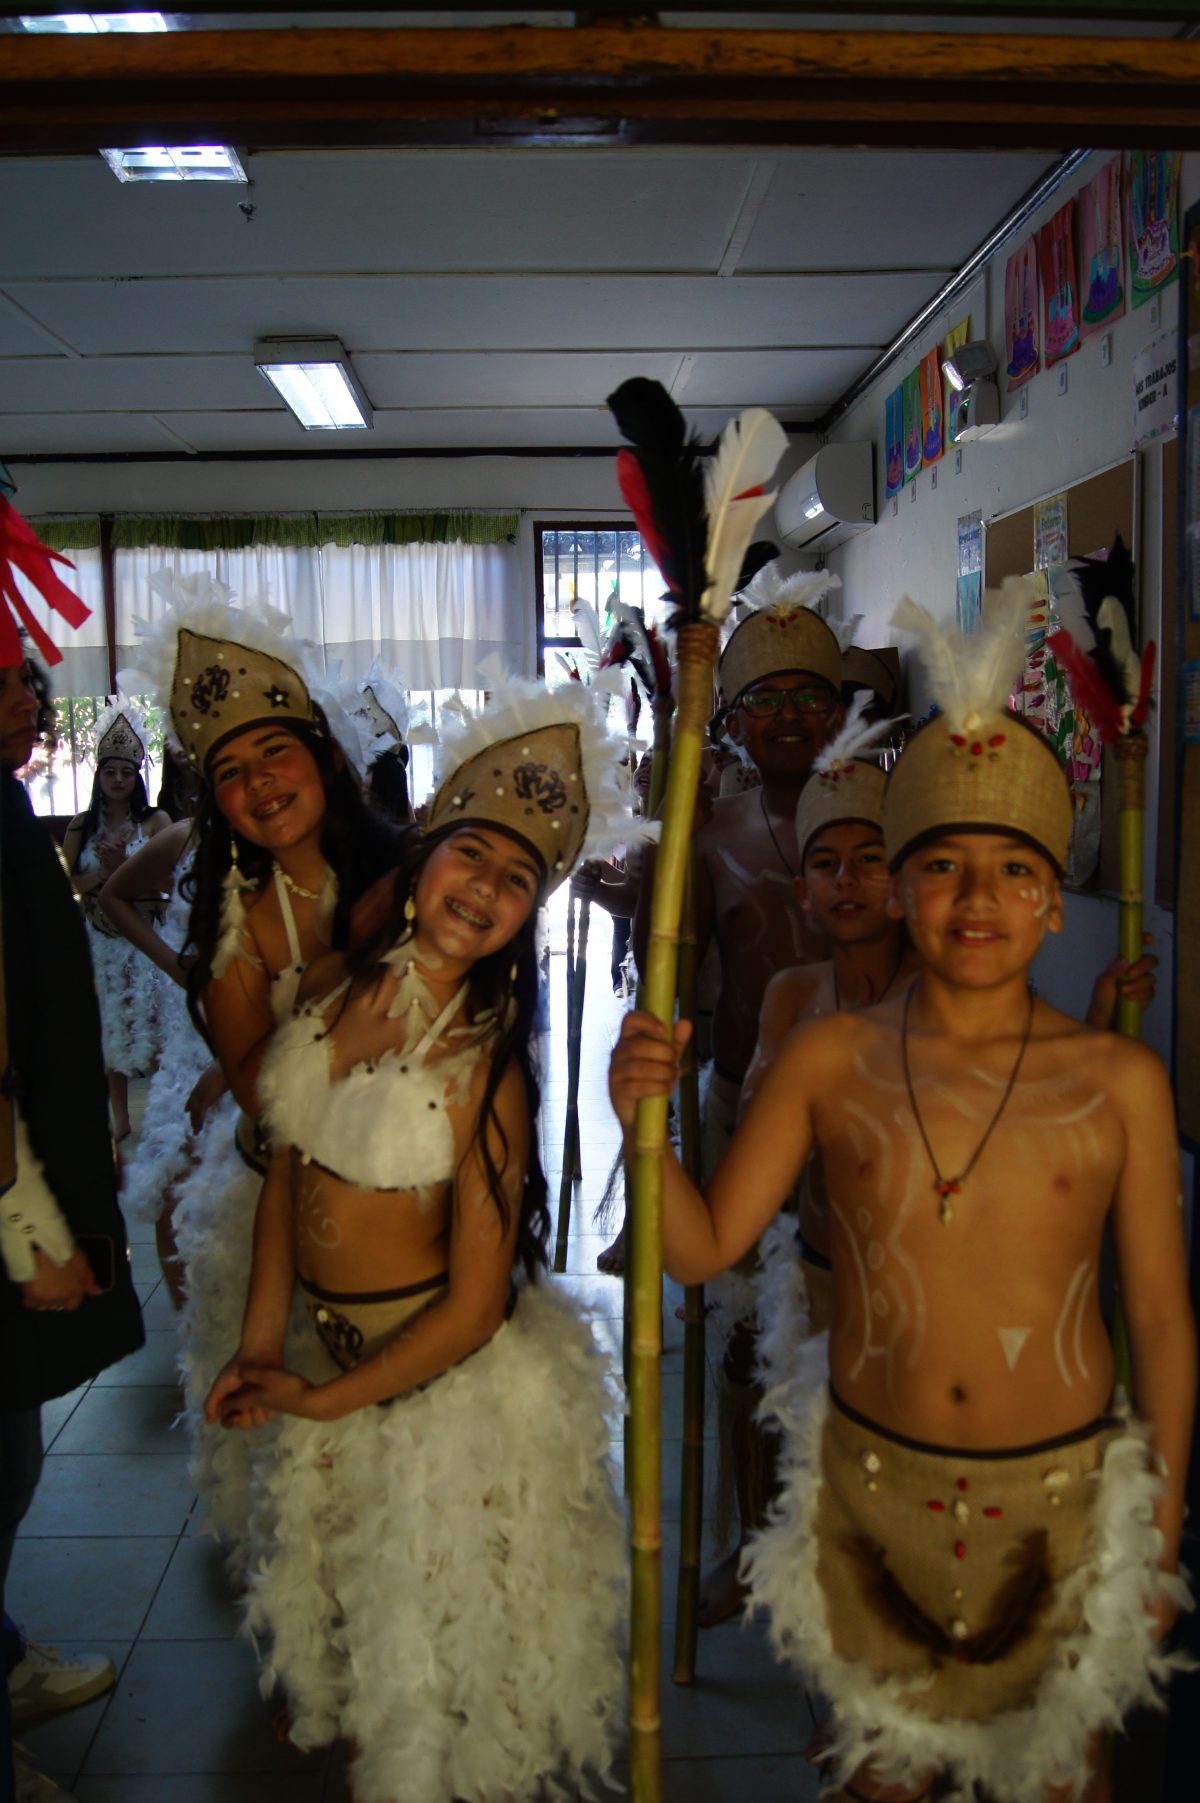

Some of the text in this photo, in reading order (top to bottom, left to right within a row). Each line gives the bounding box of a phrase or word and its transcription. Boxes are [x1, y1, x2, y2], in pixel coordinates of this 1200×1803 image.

[1145, 359, 1177, 389] TRABAJOS
[1138, 390, 1157, 412] KINDER
[1162, 383, 1168, 397] A
